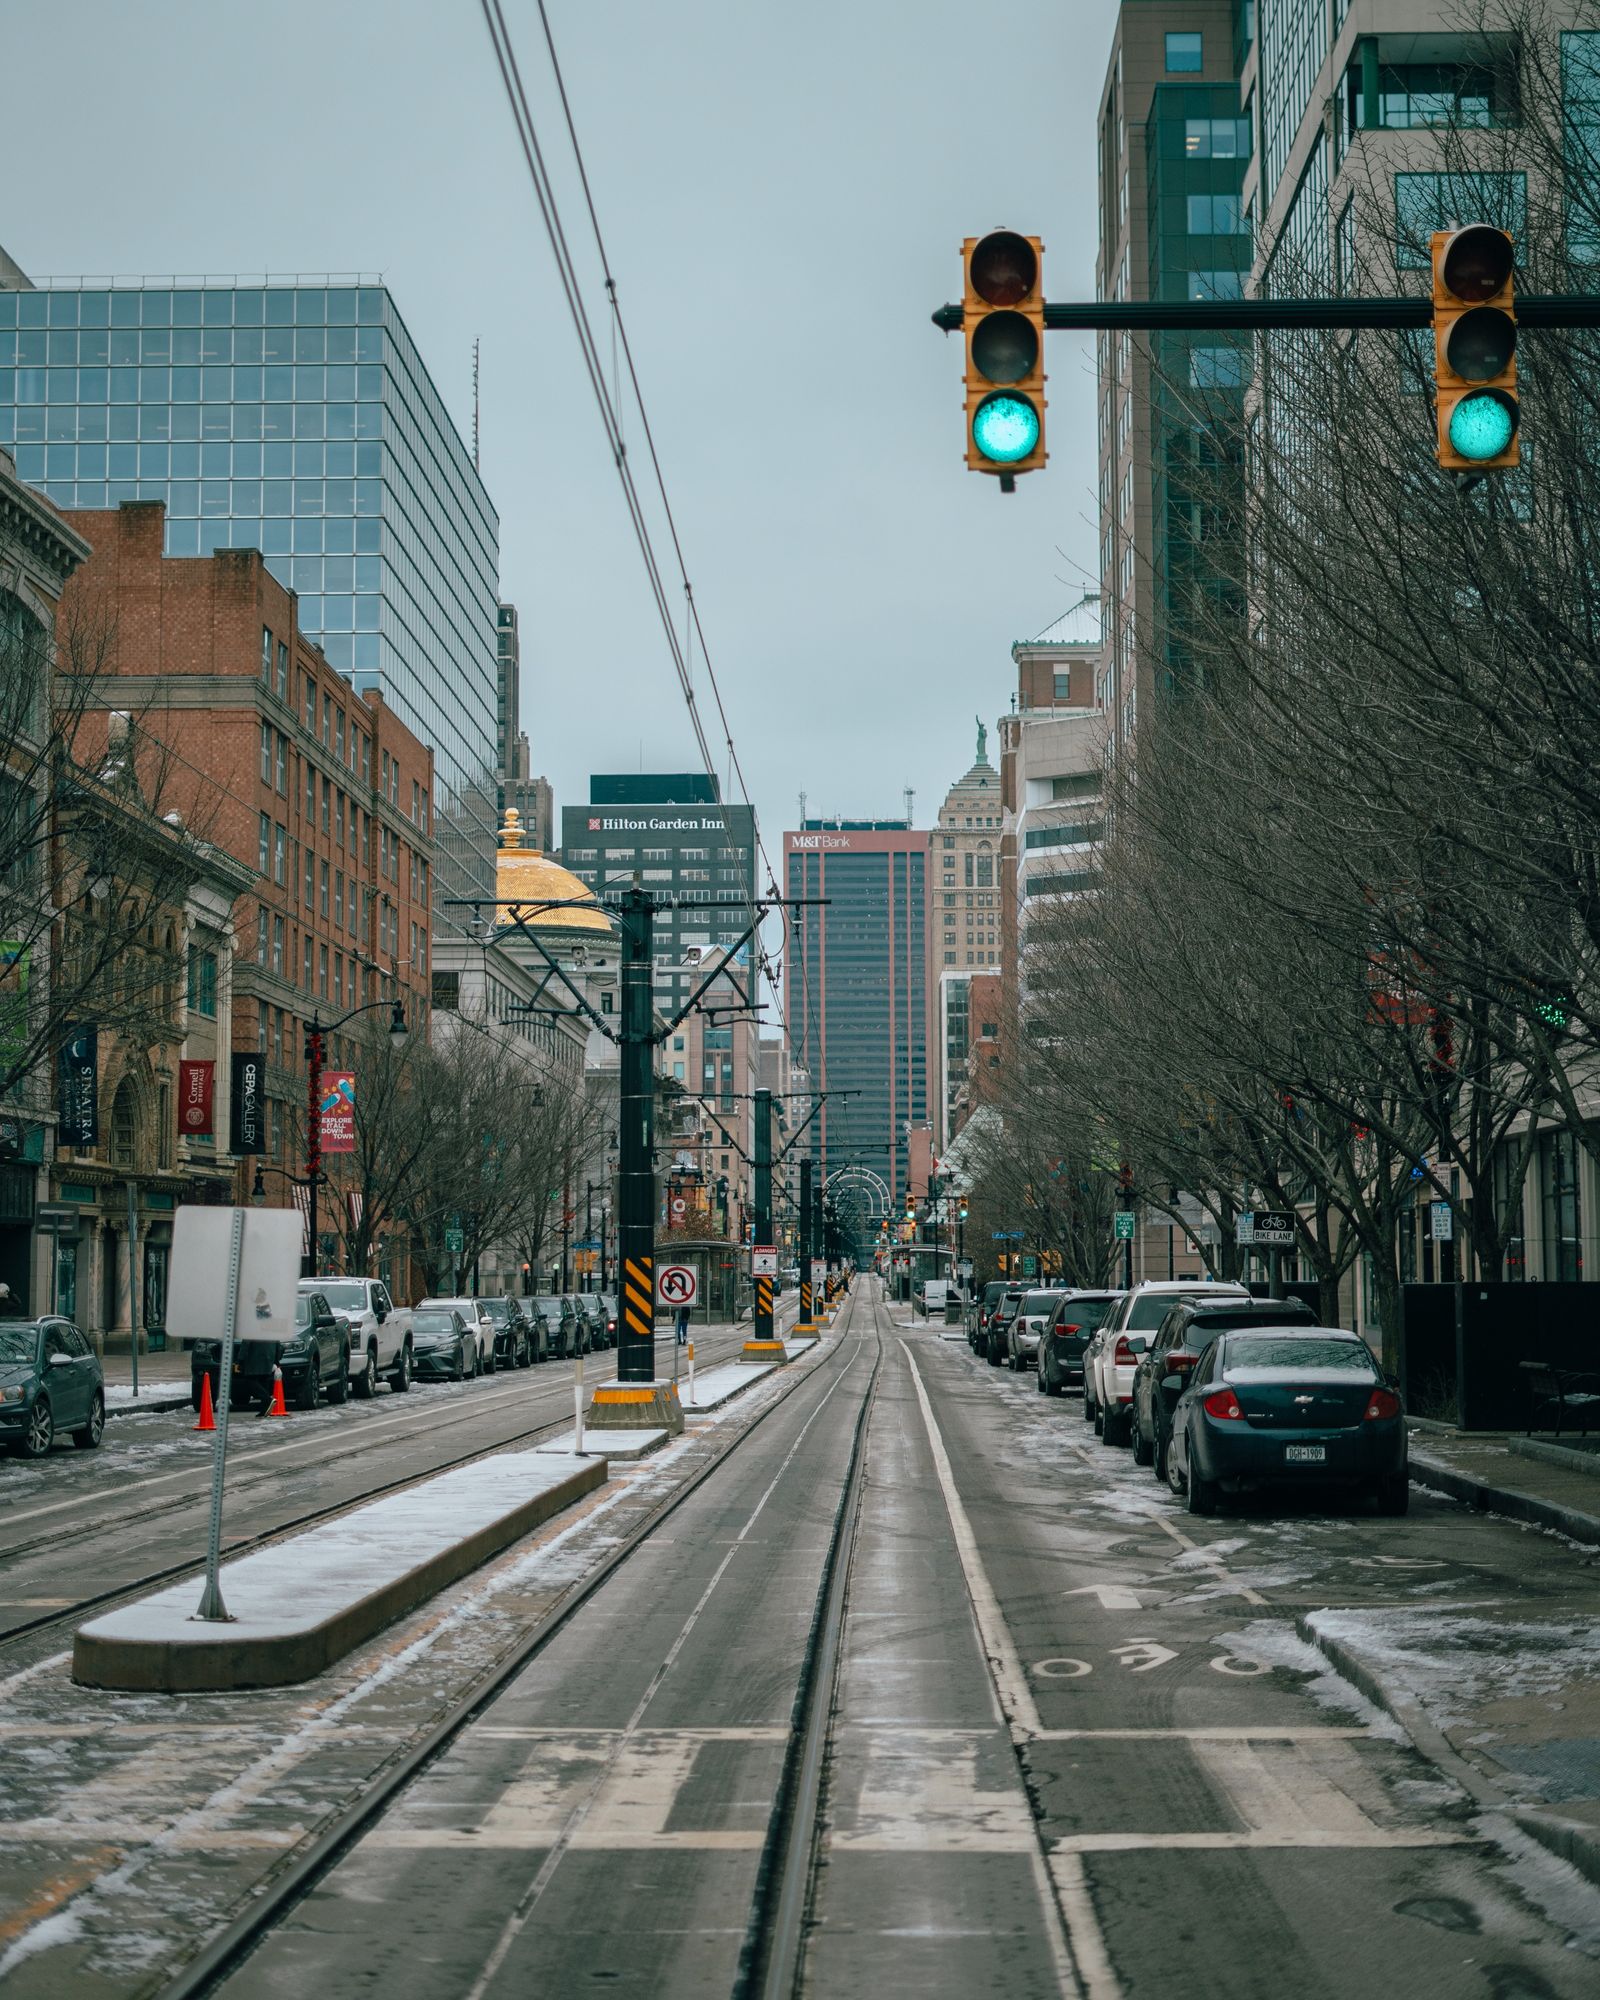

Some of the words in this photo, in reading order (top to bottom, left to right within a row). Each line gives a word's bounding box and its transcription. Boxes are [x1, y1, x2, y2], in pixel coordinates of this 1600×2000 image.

[602, 818, 647, 830] Hilton
[649, 818, 699, 830] Garden
[701, 817, 725, 829] Inn
[791, 835, 822, 848] M&T
[822, 835, 850, 848] Bank
[188, 1068, 199, 1104] Cornell
[81, 1066, 93, 1141] SINATRA
[1255, 1231, 1271, 1240] BIKE
[1273, 1232, 1293, 1241] LANE
